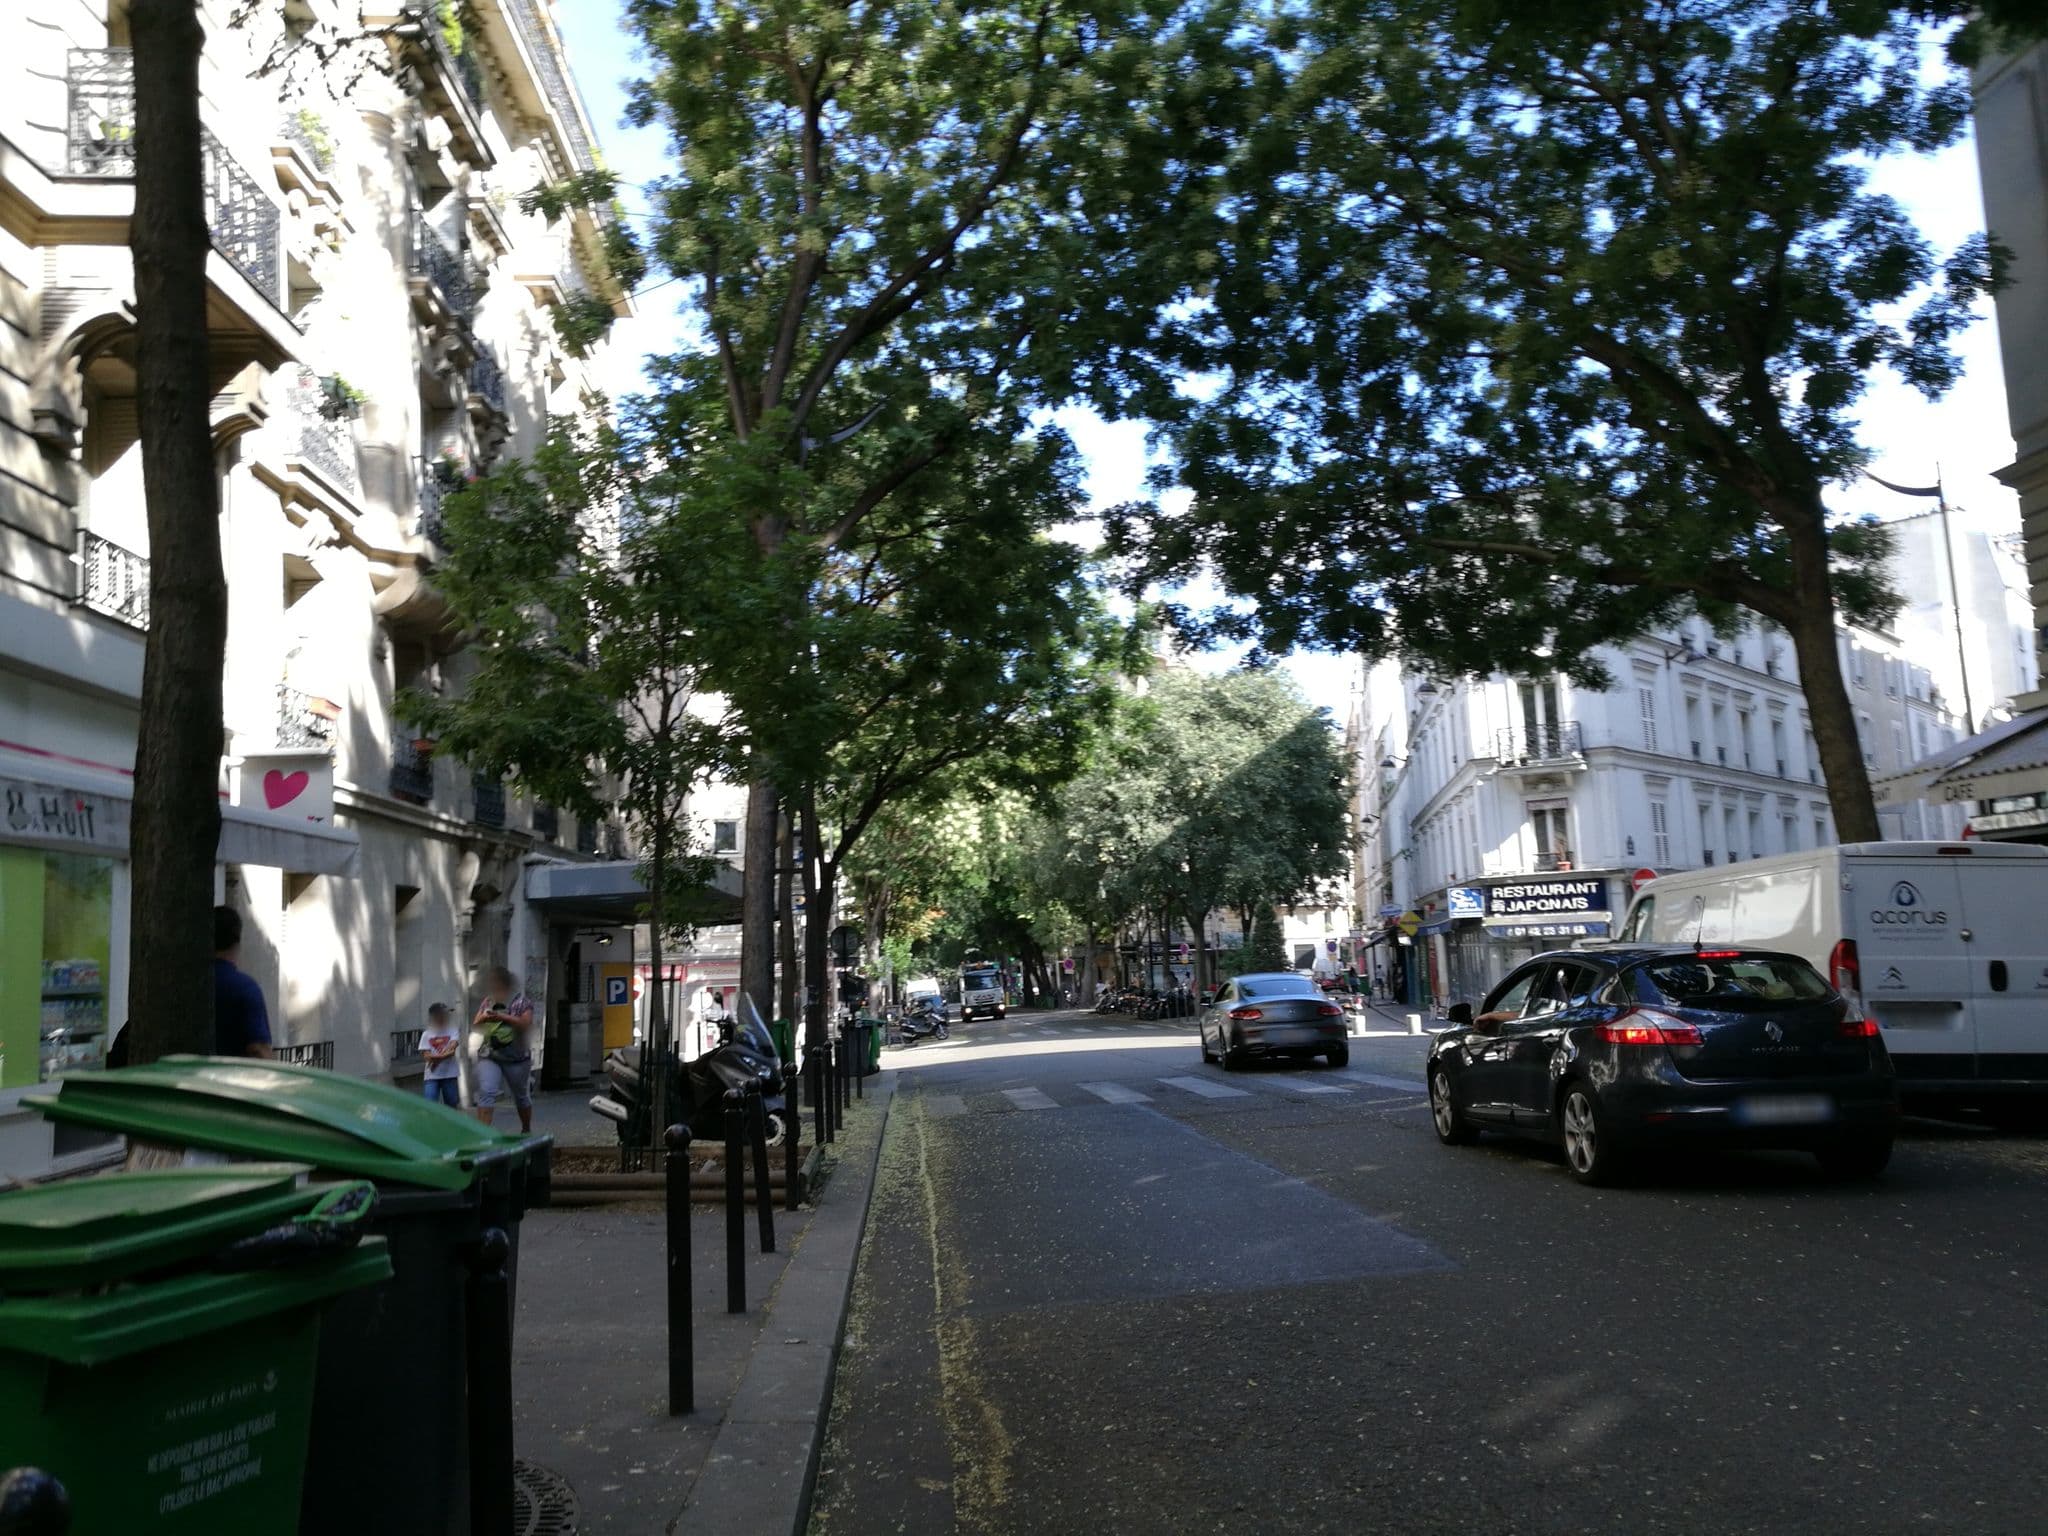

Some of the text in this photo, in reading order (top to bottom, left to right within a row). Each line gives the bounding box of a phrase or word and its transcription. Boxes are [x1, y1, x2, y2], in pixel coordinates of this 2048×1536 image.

[1492, 882, 1600, 899] RESTAURANT
[1507, 897, 1590, 913] JAPONAIS
[1870, 909, 1948, 925] acorus
[1514, 927, 1526, 936] 01
[609, 980, 625, 1004] P
